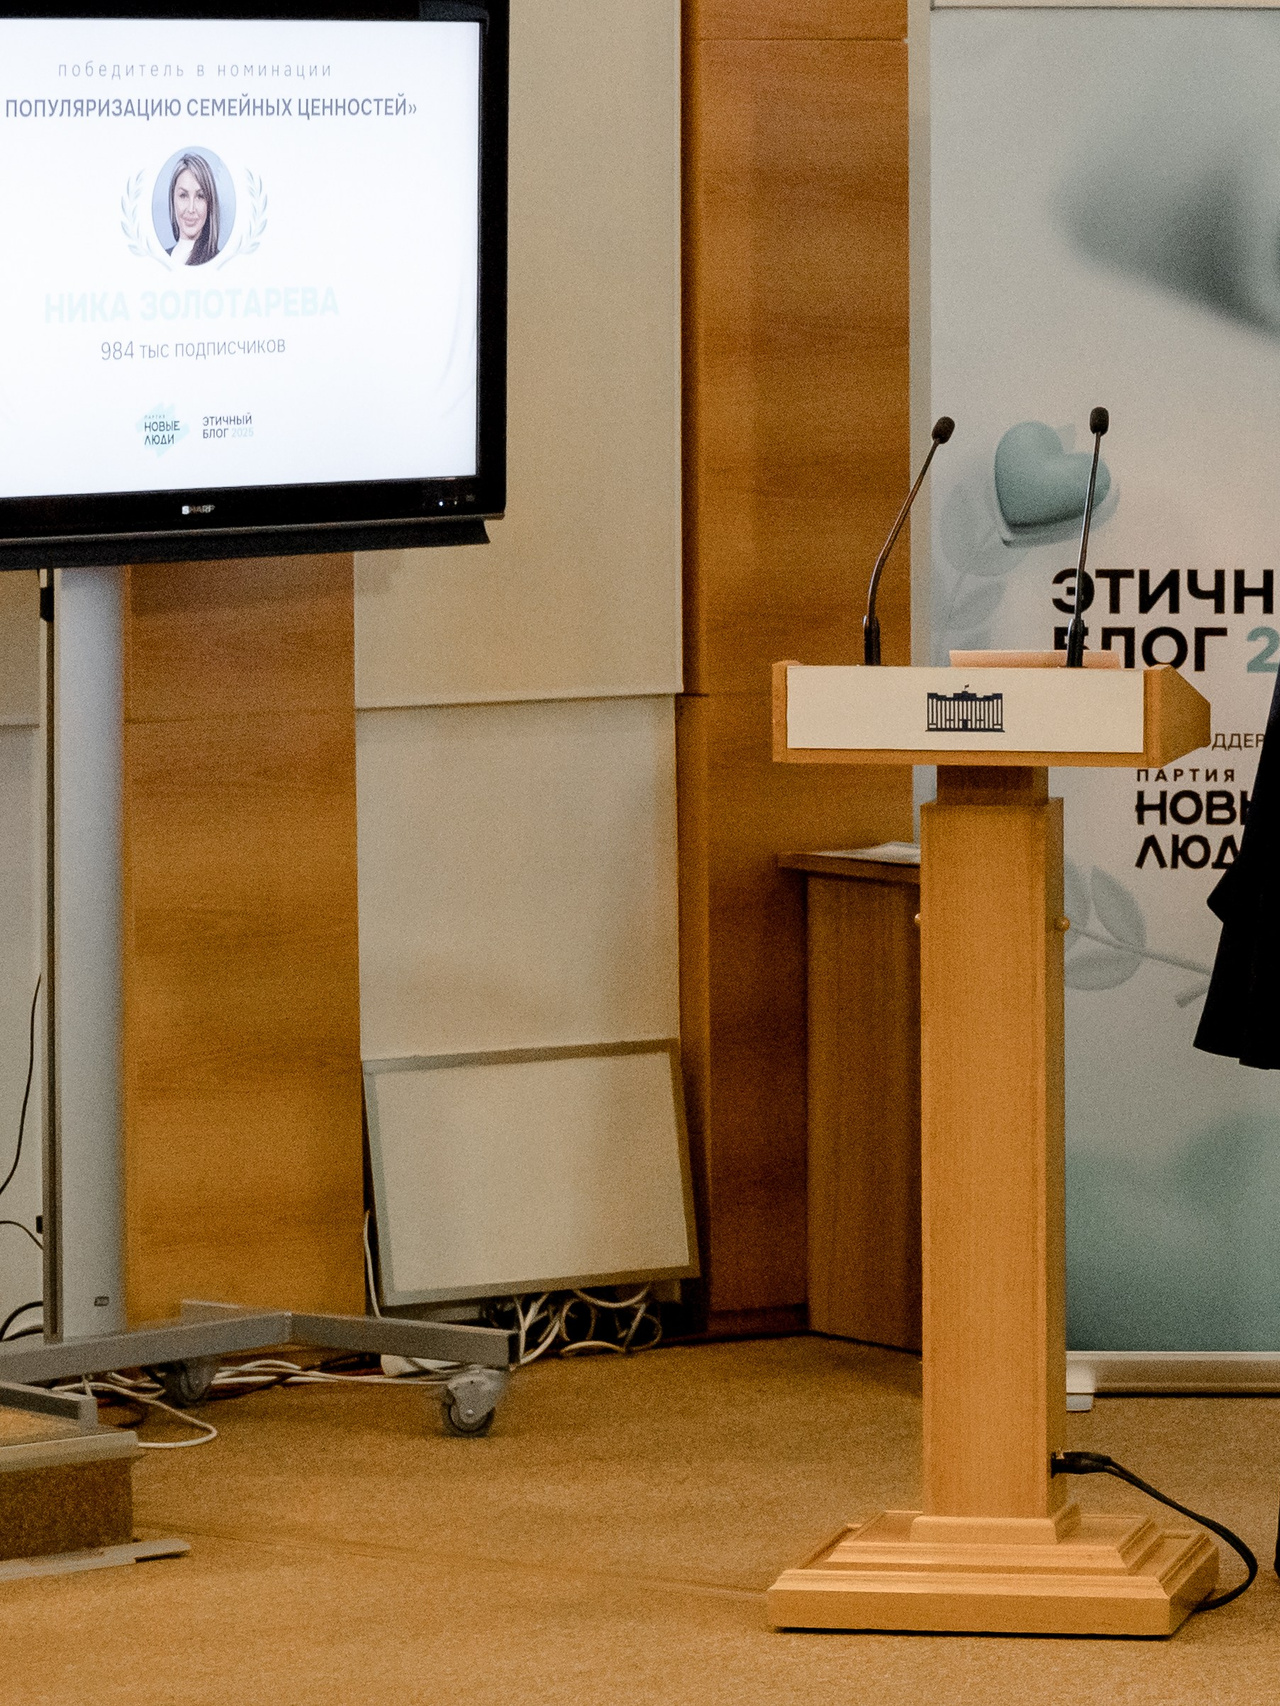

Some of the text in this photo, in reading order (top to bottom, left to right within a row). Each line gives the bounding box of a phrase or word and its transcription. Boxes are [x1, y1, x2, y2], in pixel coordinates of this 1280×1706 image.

[58, 60, 331, 80] победитель в номинации
[5, 93, 417, 121] ПОПУЛЯРИЗАЦИЮ СЕМЕЙНЫХ ЦЕННОСТЕЙ»
[44, 286, 340, 324] НИКА ЗОЛОТАРЕВА
[100, 339, 286, 361] 984 тыс подписчиков
[144, 420, 181, 433] НОВЫЕ
[202, 412, 253, 427] ЭТИЧНЫЙ
[144, 434, 175, 446] ЛЮДИ
[202, 428, 228, 439] БЛОГ
[1136, 768, 1235, 782] ПАРТИЯ
